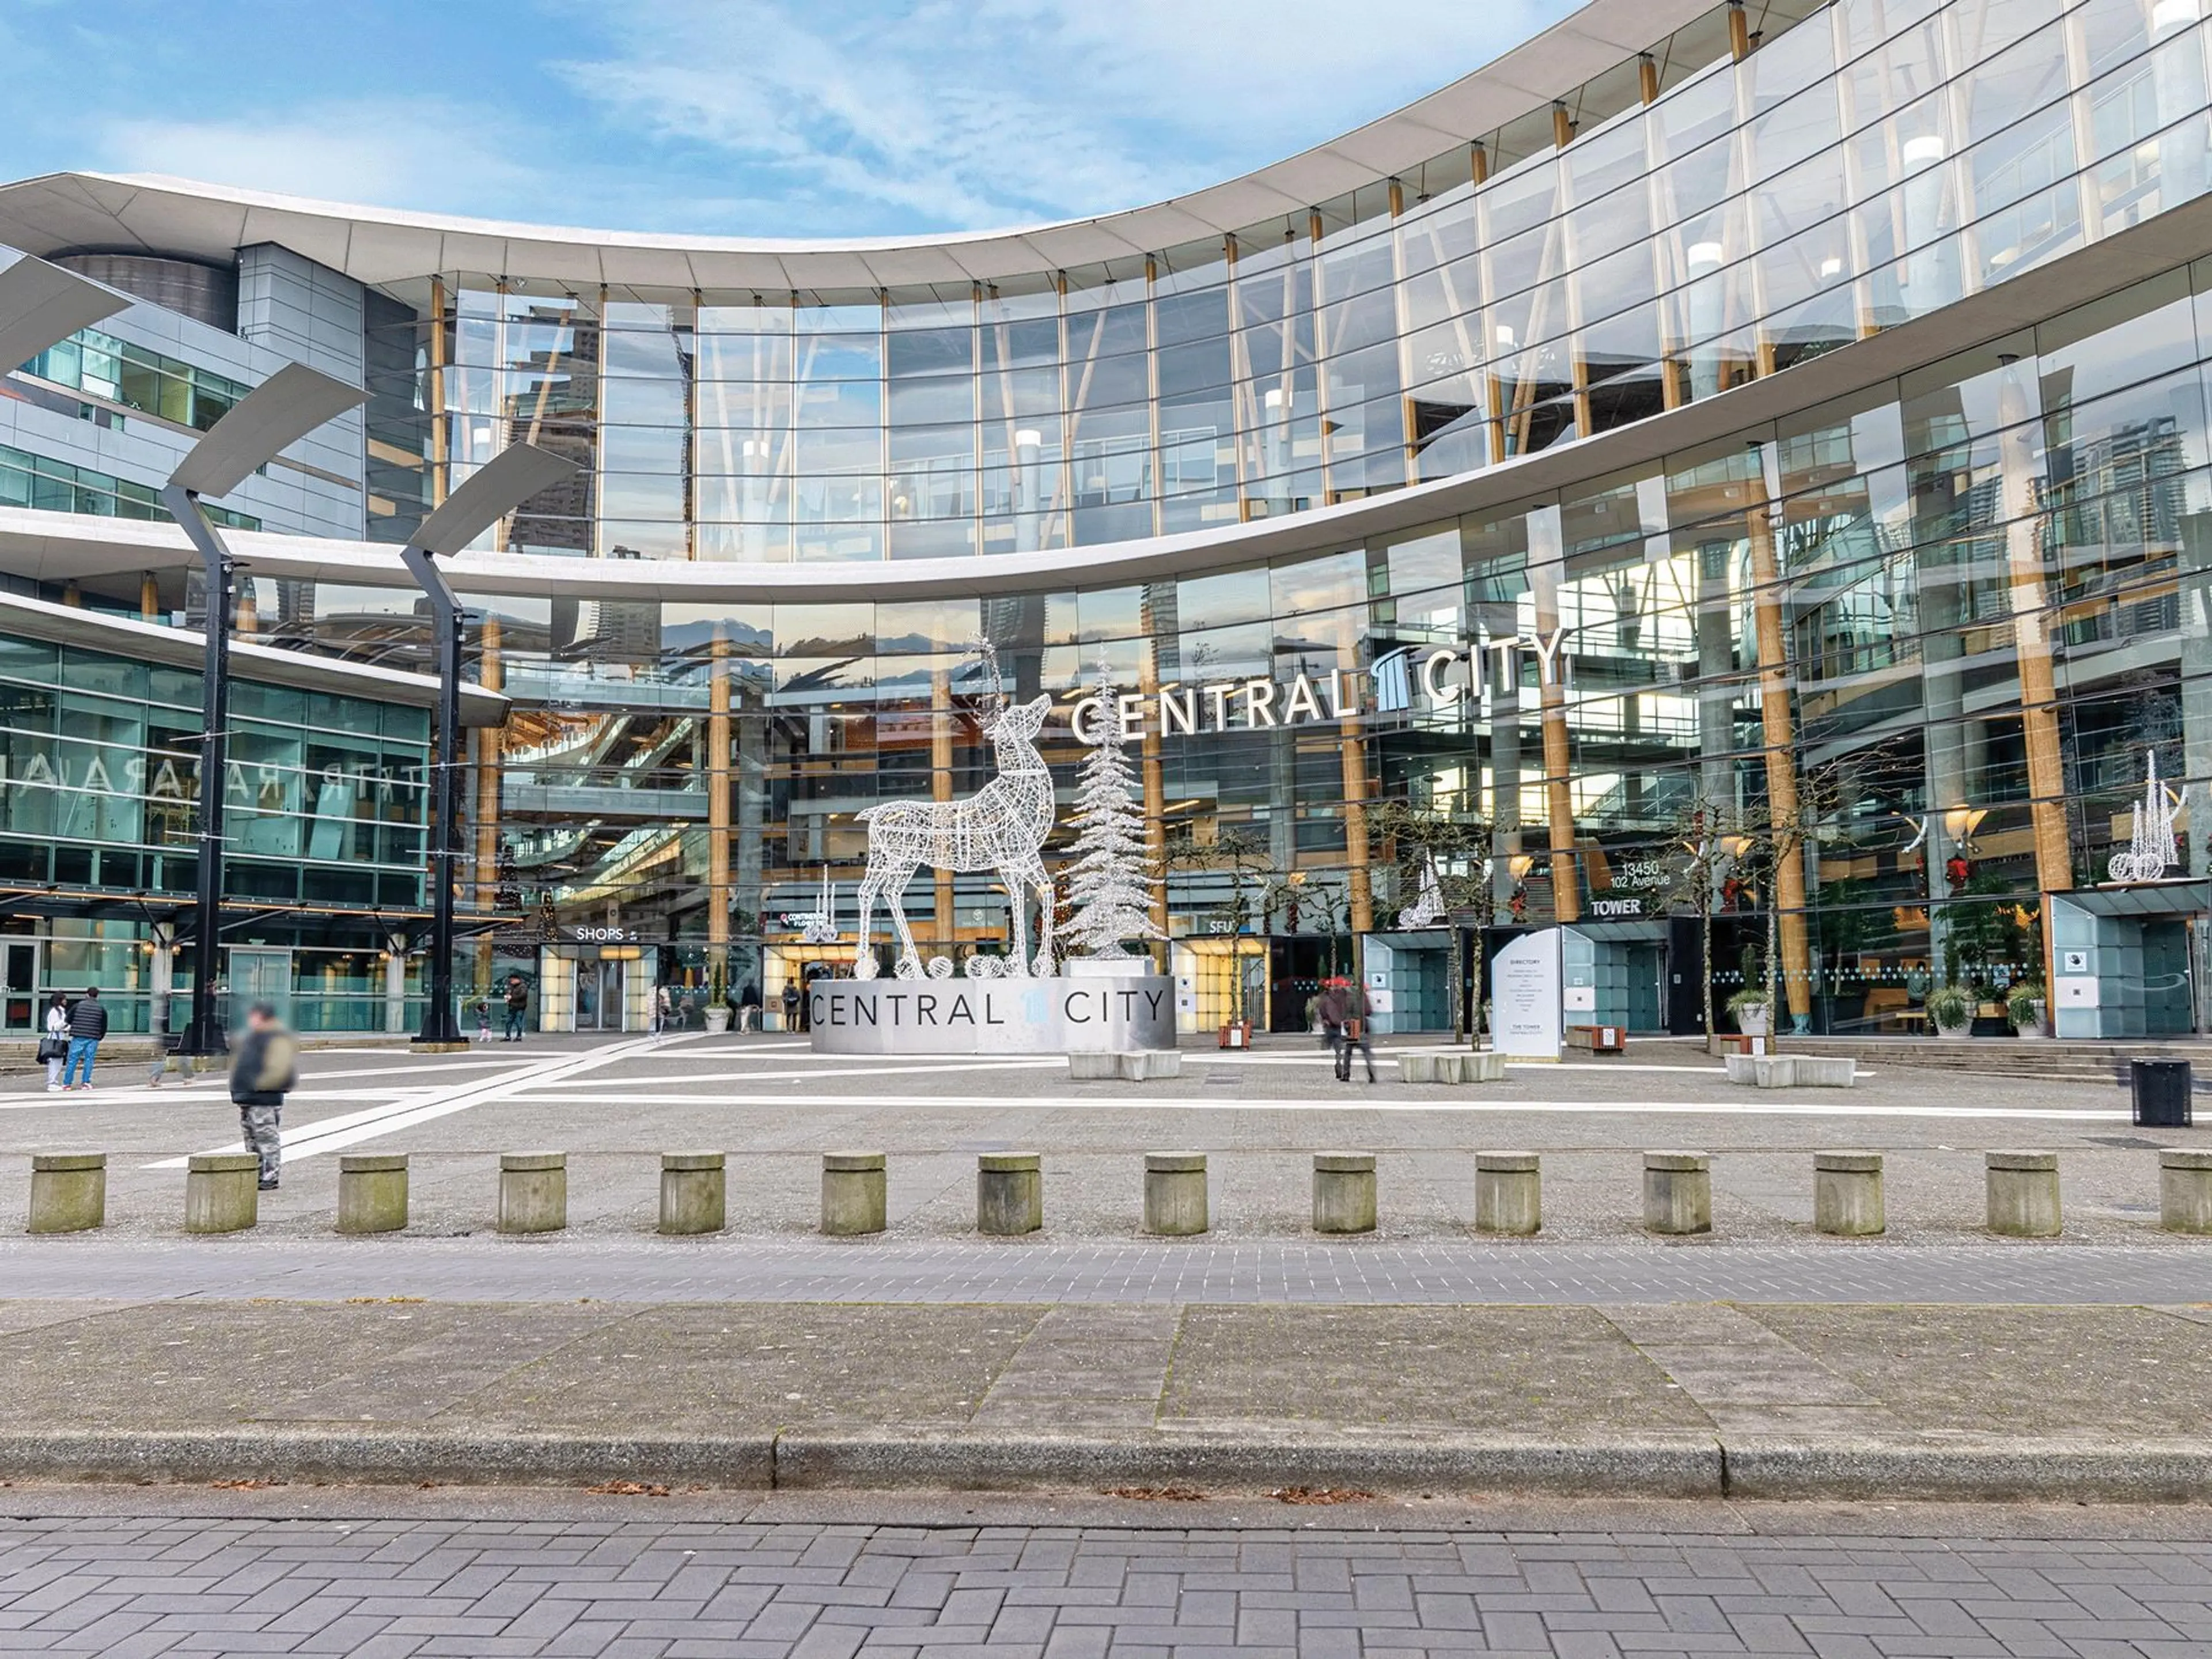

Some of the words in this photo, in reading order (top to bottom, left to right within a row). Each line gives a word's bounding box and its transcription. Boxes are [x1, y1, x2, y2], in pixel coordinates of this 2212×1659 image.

[1072, 668, 1357, 745] CENTRAL
[1424, 627, 1563, 703] CITY
[1622, 861, 1659, 877] 13450
[1611, 876, 1628, 888] 102
[1631, 874, 1671, 887] Avenue
[1590, 899, 1641, 915] TOWER
[787, 912, 829, 921] CONTINEN
[576, 927, 624, 940] SHOPS
[1210, 921, 1232, 933] SFU
[811, 993, 1004, 1026] CENTRAL
[1065, 990, 1164, 1023] CITY
